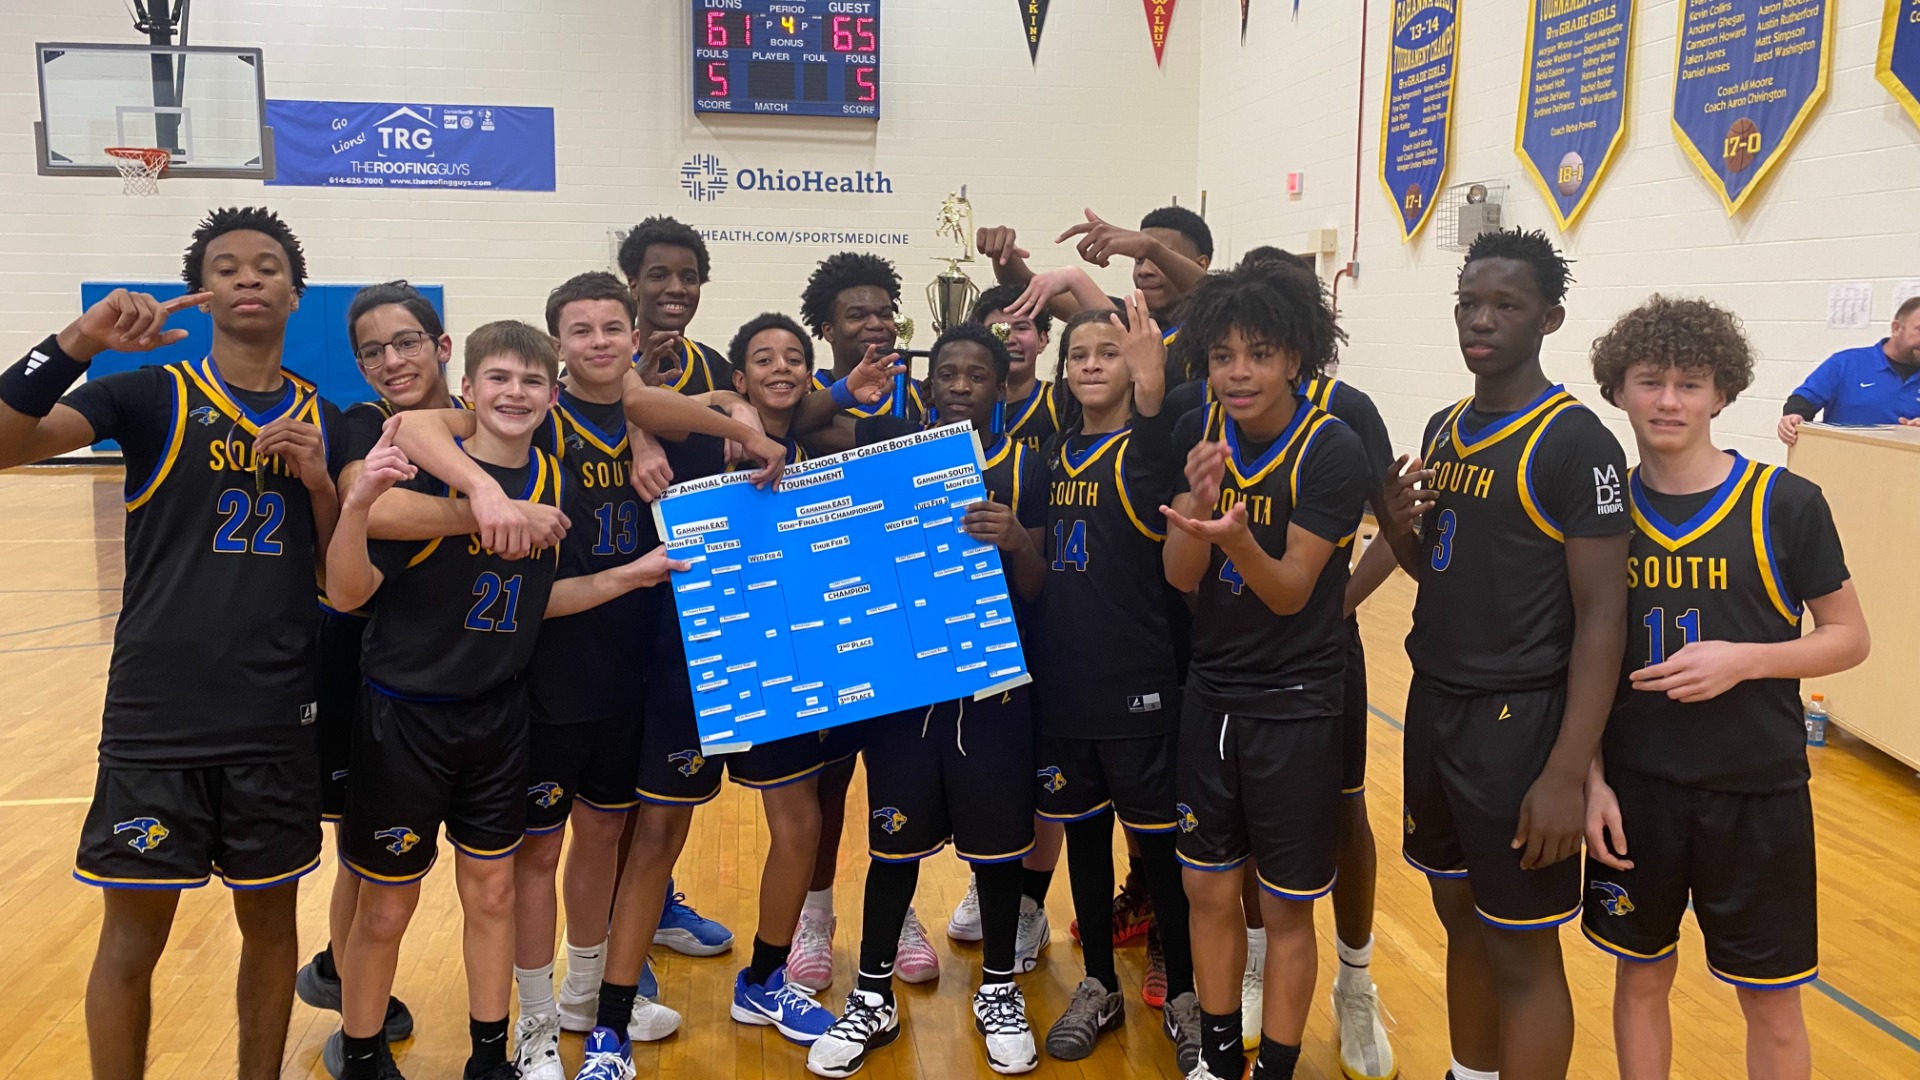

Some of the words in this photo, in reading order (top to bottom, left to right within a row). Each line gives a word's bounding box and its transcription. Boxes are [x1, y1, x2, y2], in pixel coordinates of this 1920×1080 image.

[704, 0, 744, 9] LIONS
[769, 4, 805, 14] PERIOD
[828, 2, 871, 14] GUEST
[1689, 8, 1708, 21] Kevin
[1710, 2, 1732, 15] Collins
[1758, 3, 1781, 17] Aaron
[766, 20, 773, 30] P
[781, 16, 795, 34] 4
[801, 22, 809, 31] P
[1029, 0, 1038, 42] KINS
[1560, 14, 1589, 36] GRADE
[1590, 5, 1616, 25] GIRLS
[1757, 17, 1779, 31] Austin
[1780, 4, 1819, 25] Rutherford
[707, 11, 751, 47] 61
[833, 16, 876, 52] 65
[1409, 16, 1439, 41] 13-14
[1686, 36, 1718, 50] Cameron
[1719, 25, 1747, 43] Howard
[1689, 22, 1716, 36] Andrew
[1755, 36, 1771, 48] Matt
[1773, 26, 1805, 42] Simpson
[770, 38, 804, 48] BONUS
[1753, 50, 1772, 63] Jared
[1774, 39, 1816, 58] Washington
[696, 49, 729, 59] FOULS
[752, 51, 790, 61] PLAYER
[803, 53, 828, 63] FOUL
[845, 54, 877, 64] FOULS
[1684, 54, 1703, 66] Jalen
[1705, 48, 1726, 61] Jones
[708, 62, 728, 97] 5
[1428, 64, 1446, 79] GIRLS
[1682, 67, 1706, 80] Daniel
[1706, 61, 1730, 74] Moses
[856, 67, 876, 102] 5
[1717, 83, 1739, 97] Coach
[1749, 76, 1774, 90] Moore
[697, 99, 732, 110] SCORE
[754, 102, 788, 112] MATCH
[842, 104, 876, 115] SCORE
[1704, 99, 1726, 113] Coach
[1727, 95, 1746, 109] Aaron
[1747, 88, 1787, 105] Chivington
[332, 117, 348, 131] Go
[1550, 127, 1565, 137] Coach
[1578, 120, 1597, 131] Powers
[332, 132, 366, 154] Lions!
[378, 128, 432, 150] TRG
[1723, 132, 1762, 158] 17-0
[390, 178, 492, 187] www.theroofingguys.com
[736, 168, 893, 194] OhioHealth
[1558, 164, 1583, 184] 18-1
[1405, 194, 1422, 209] 17-1
[701, 230, 909, 246] HEALTH.COM/SPORTSMEDICINE
[210, 440, 290, 477] SOU
[680, 478, 721, 494] ANNUAL
[721, 473, 752, 484] GAHA
[783, 465, 801, 477] DLE
[802, 457, 839, 472] SCHOOL
[842, 450, 856, 461] 8TH
[857, 444, 889, 457] GRADE
[889, 438, 914, 450] BOYS
[915, 423, 971, 444] BASKETBALL
[582, 461, 633, 488] SOUT
[781, 470, 842, 491] TOURNAMENT
[916, 474, 948, 485] GAHANNA
[948, 466, 974, 477] SOUTH
[1429, 461, 1495, 499] SOUTH
[945, 481, 962, 490] MON
[963, 478, 975, 486] FEB
[1049, 481, 1098, 507] SOUTH
[800, 504, 831, 515] GAHANNA
[832, 498, 850, 508] EAST
[915, 502, 930, 510] TUES
[931, 499, 943, 507] FEB
[1213, 488, 1272, 526] OTH
[1597, 503, 1623, 515] HOOPS
[213, 488, 285, 556] 22
[779, 516, 823, 530] SEMI-FINALS
[831, 503, 883, 520] CHAMPIONSHIP
[901, 519, 912, 527] FEB
[592, 500, 638, 556] 13
[676, 524, 710, 535] GAHANNA
[710, 520, 729, 530] EAST
[667, 541, 684, 549] MON
[723, 541, 735, 549] FEB
[813, 542, 830, 551] THUR
[831, 539, 843, 547] FEB
[1052, 520, 1089, 571] 14
[1431, 509, 1457, 572] 3
[749, 555, 763, 563] WED
[1627, 556, 1728, 590] SOUTH
[464, 571, 522, 632] 21
[828, 585, 869, 600] CHAMPION
[851, 639, 872, 649] PLACE
[1644, 607, 1701, 667] 11
[850, 692, 872, 702] PLACE
